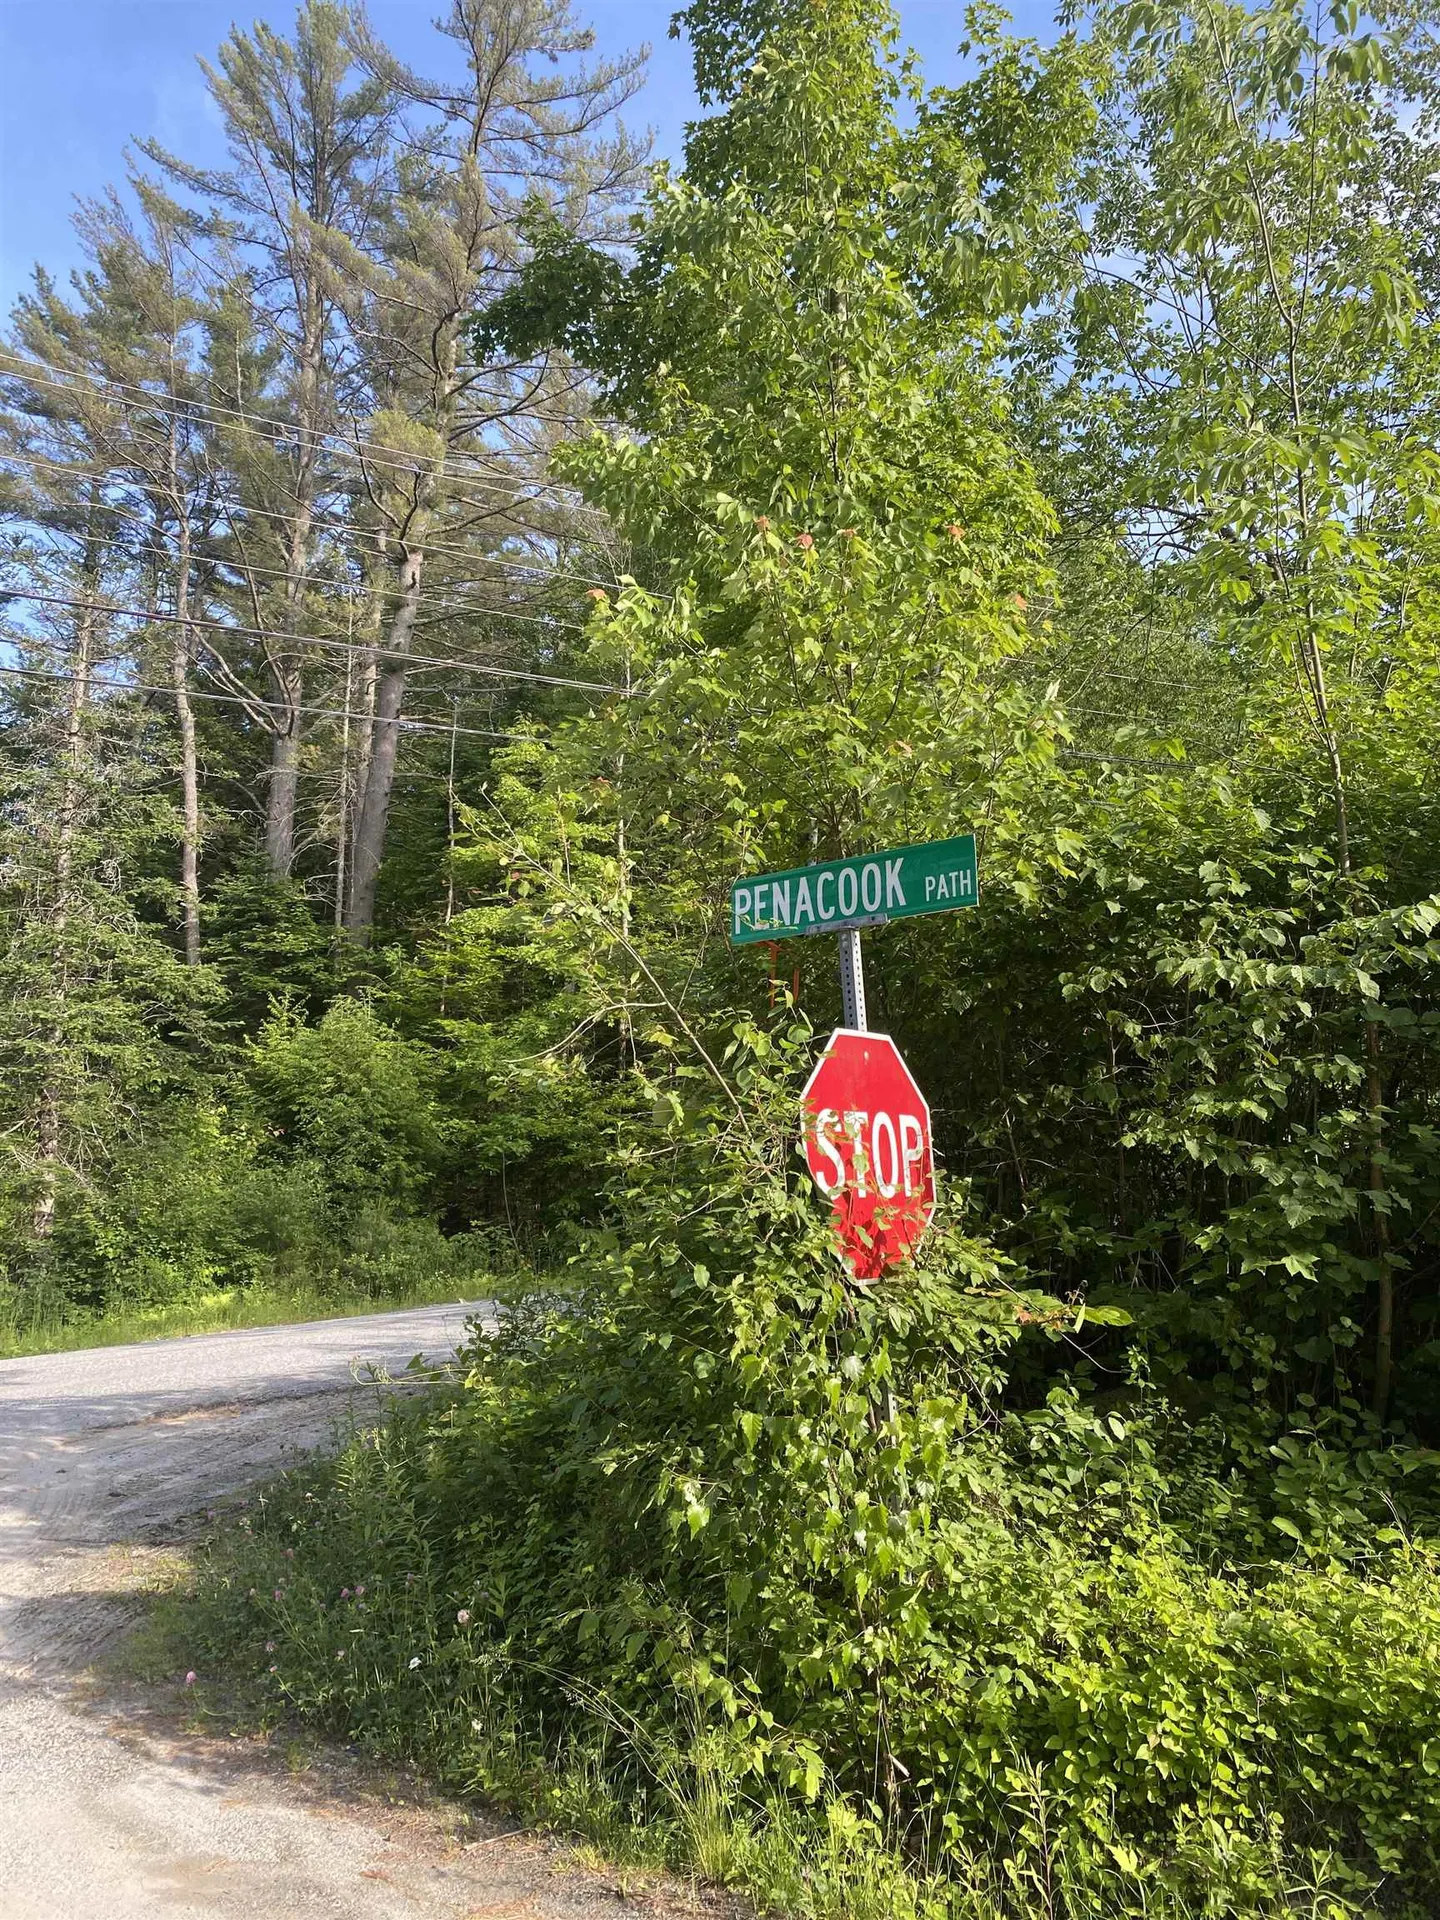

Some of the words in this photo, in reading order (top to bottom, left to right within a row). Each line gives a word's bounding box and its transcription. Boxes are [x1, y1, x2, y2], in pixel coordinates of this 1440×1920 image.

[734, 858, 906, 934] PENACOOK
[925, 870, 972, 901] PATH
[815, 1108, 924, 1200] STOP
